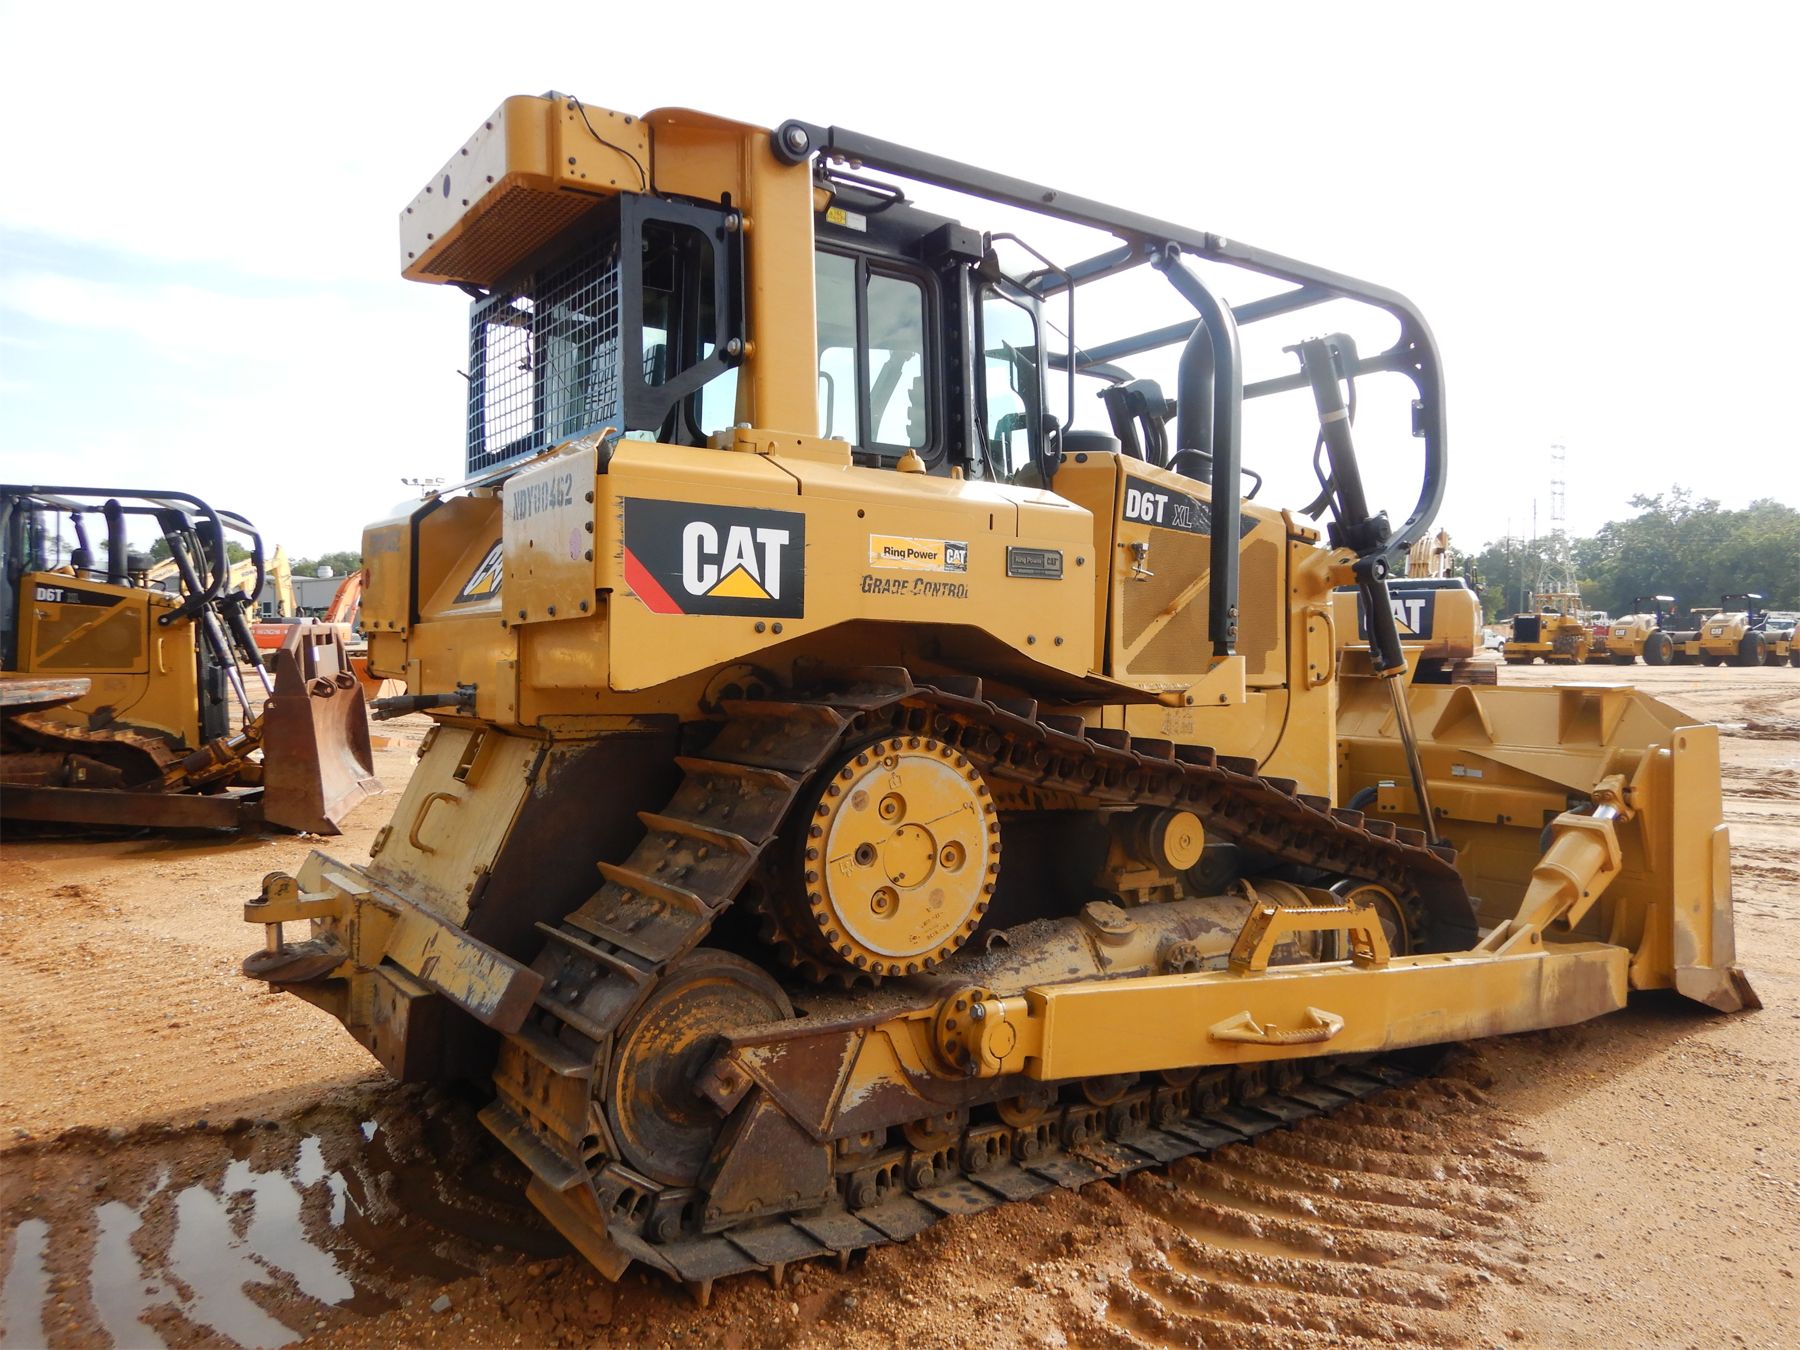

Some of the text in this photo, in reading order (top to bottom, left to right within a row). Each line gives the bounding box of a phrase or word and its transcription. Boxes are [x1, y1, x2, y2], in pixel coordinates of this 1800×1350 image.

[1126, 488, 1192, 528] D6T XL
[682, 521, 790, 600] CAT
[883, 546, 938, 560] Ring Power
[946, 549, 967, 565] CAT
[463, 542, 503, 597] CA
[36, 587, 64, 602] D6T
[860, 574, 909, 595] GRADE
